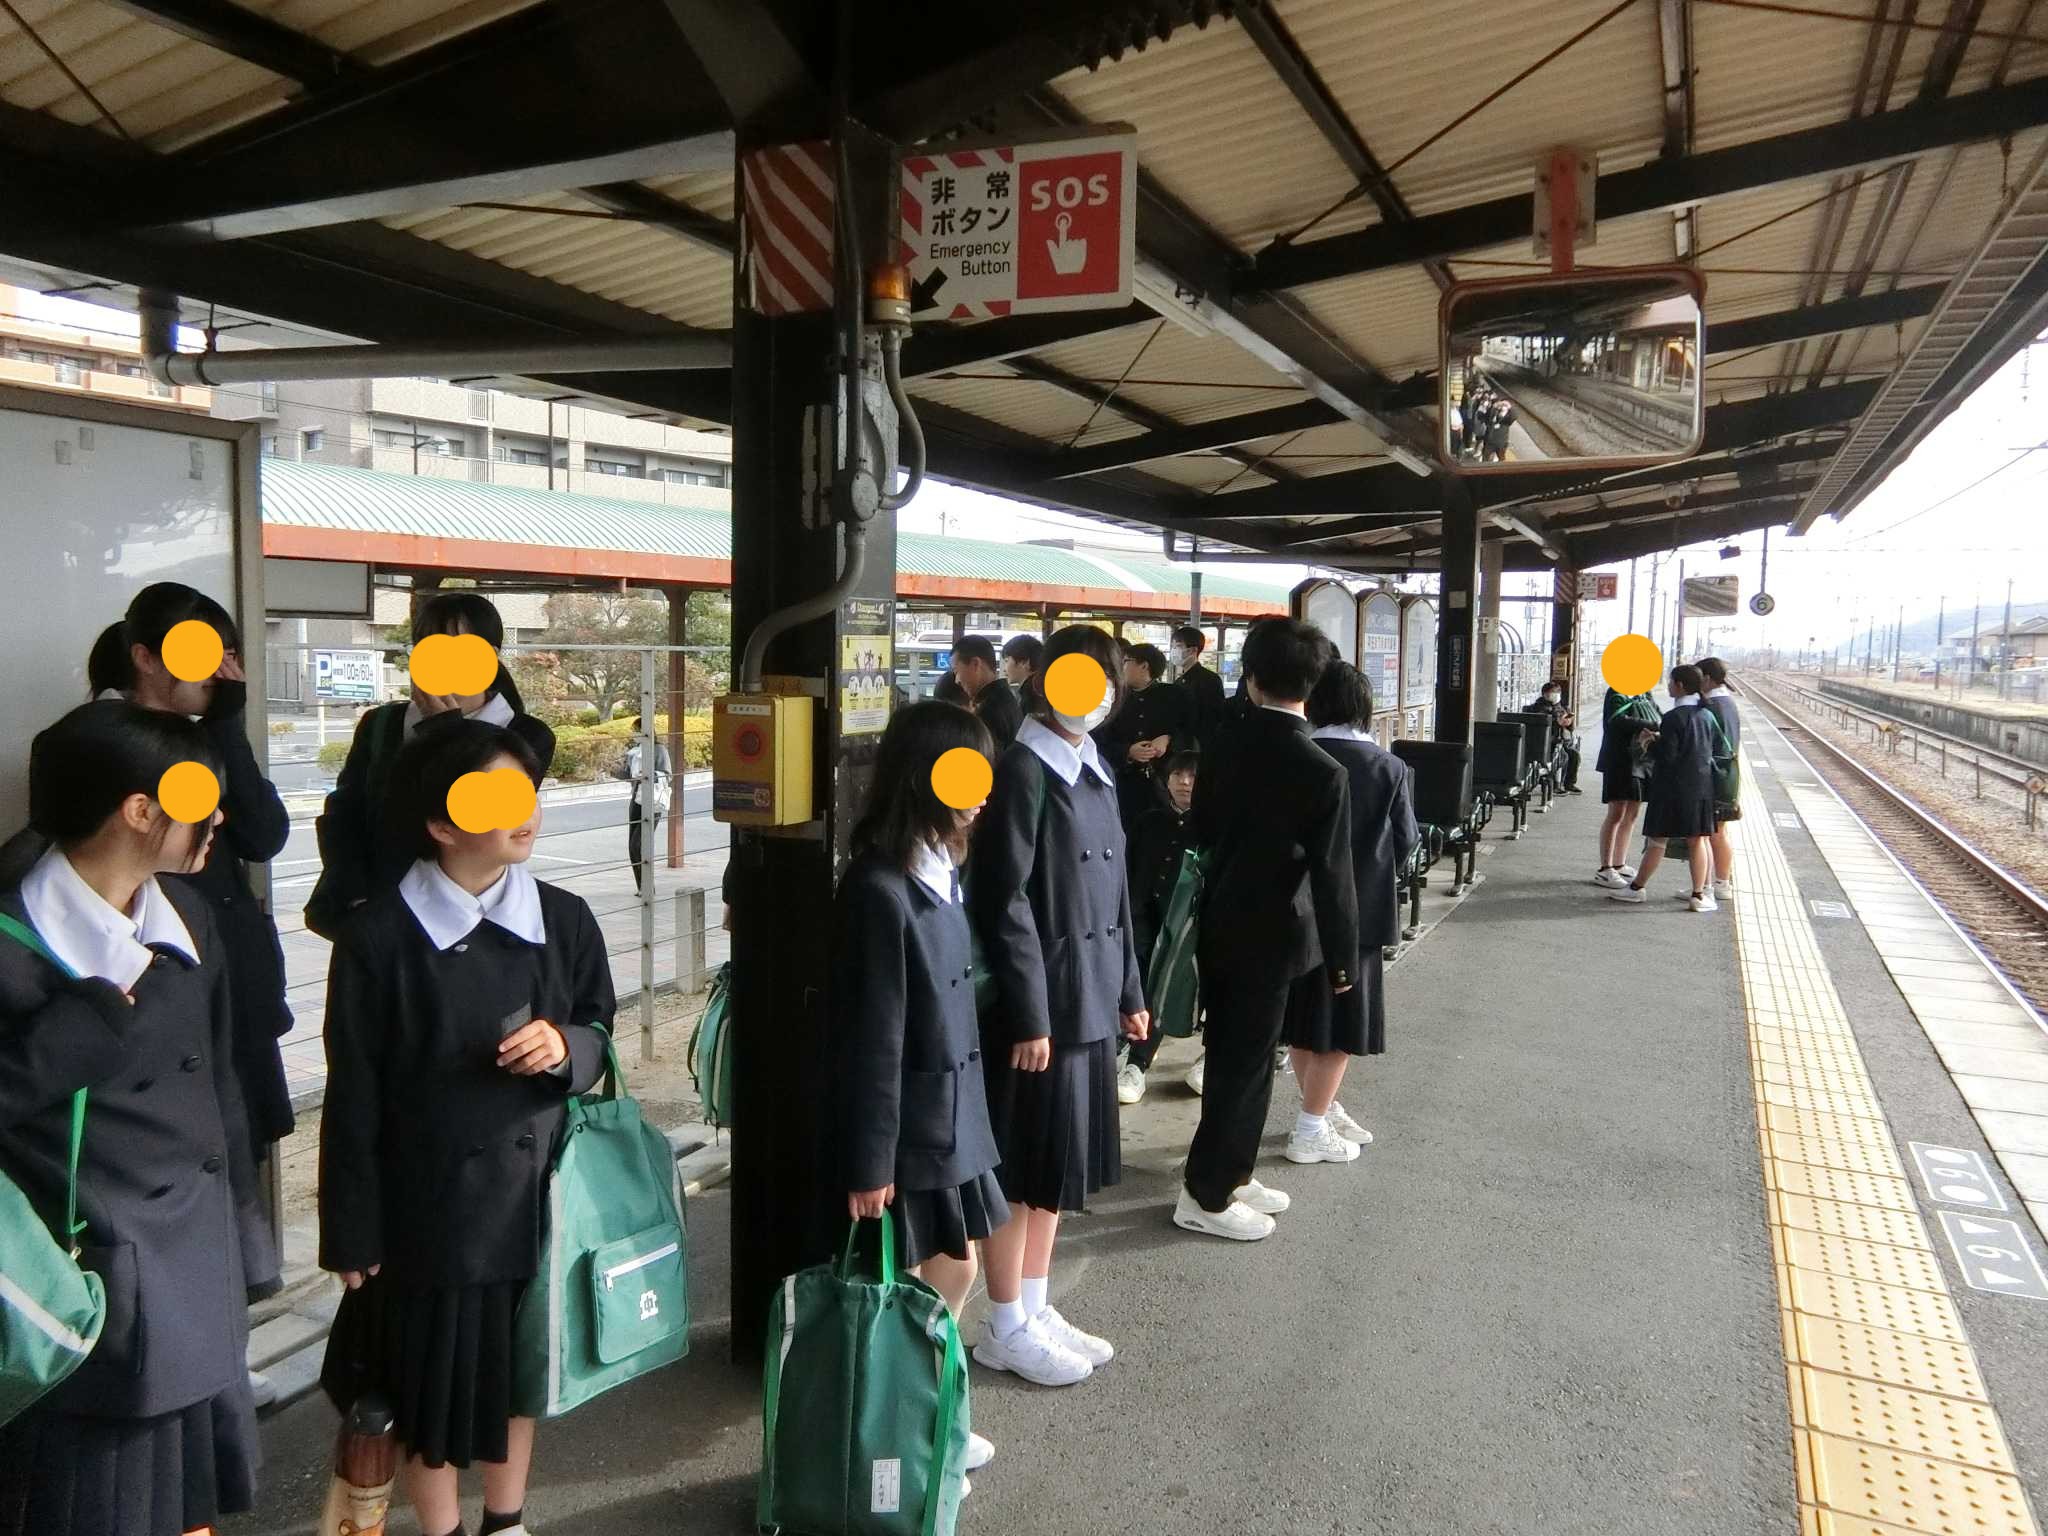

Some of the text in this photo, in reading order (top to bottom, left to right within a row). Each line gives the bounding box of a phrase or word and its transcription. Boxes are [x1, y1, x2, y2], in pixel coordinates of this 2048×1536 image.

[931, 171, 1010, 205] 非常
[1031, 173, 1110, 212] SOS
[932, 207, 1010, 236] ボタン
[930, 240, 1010, 260] Emergency
[961, 259, 1010, 277] Button
[1756, 597, 1768, 611] 6
